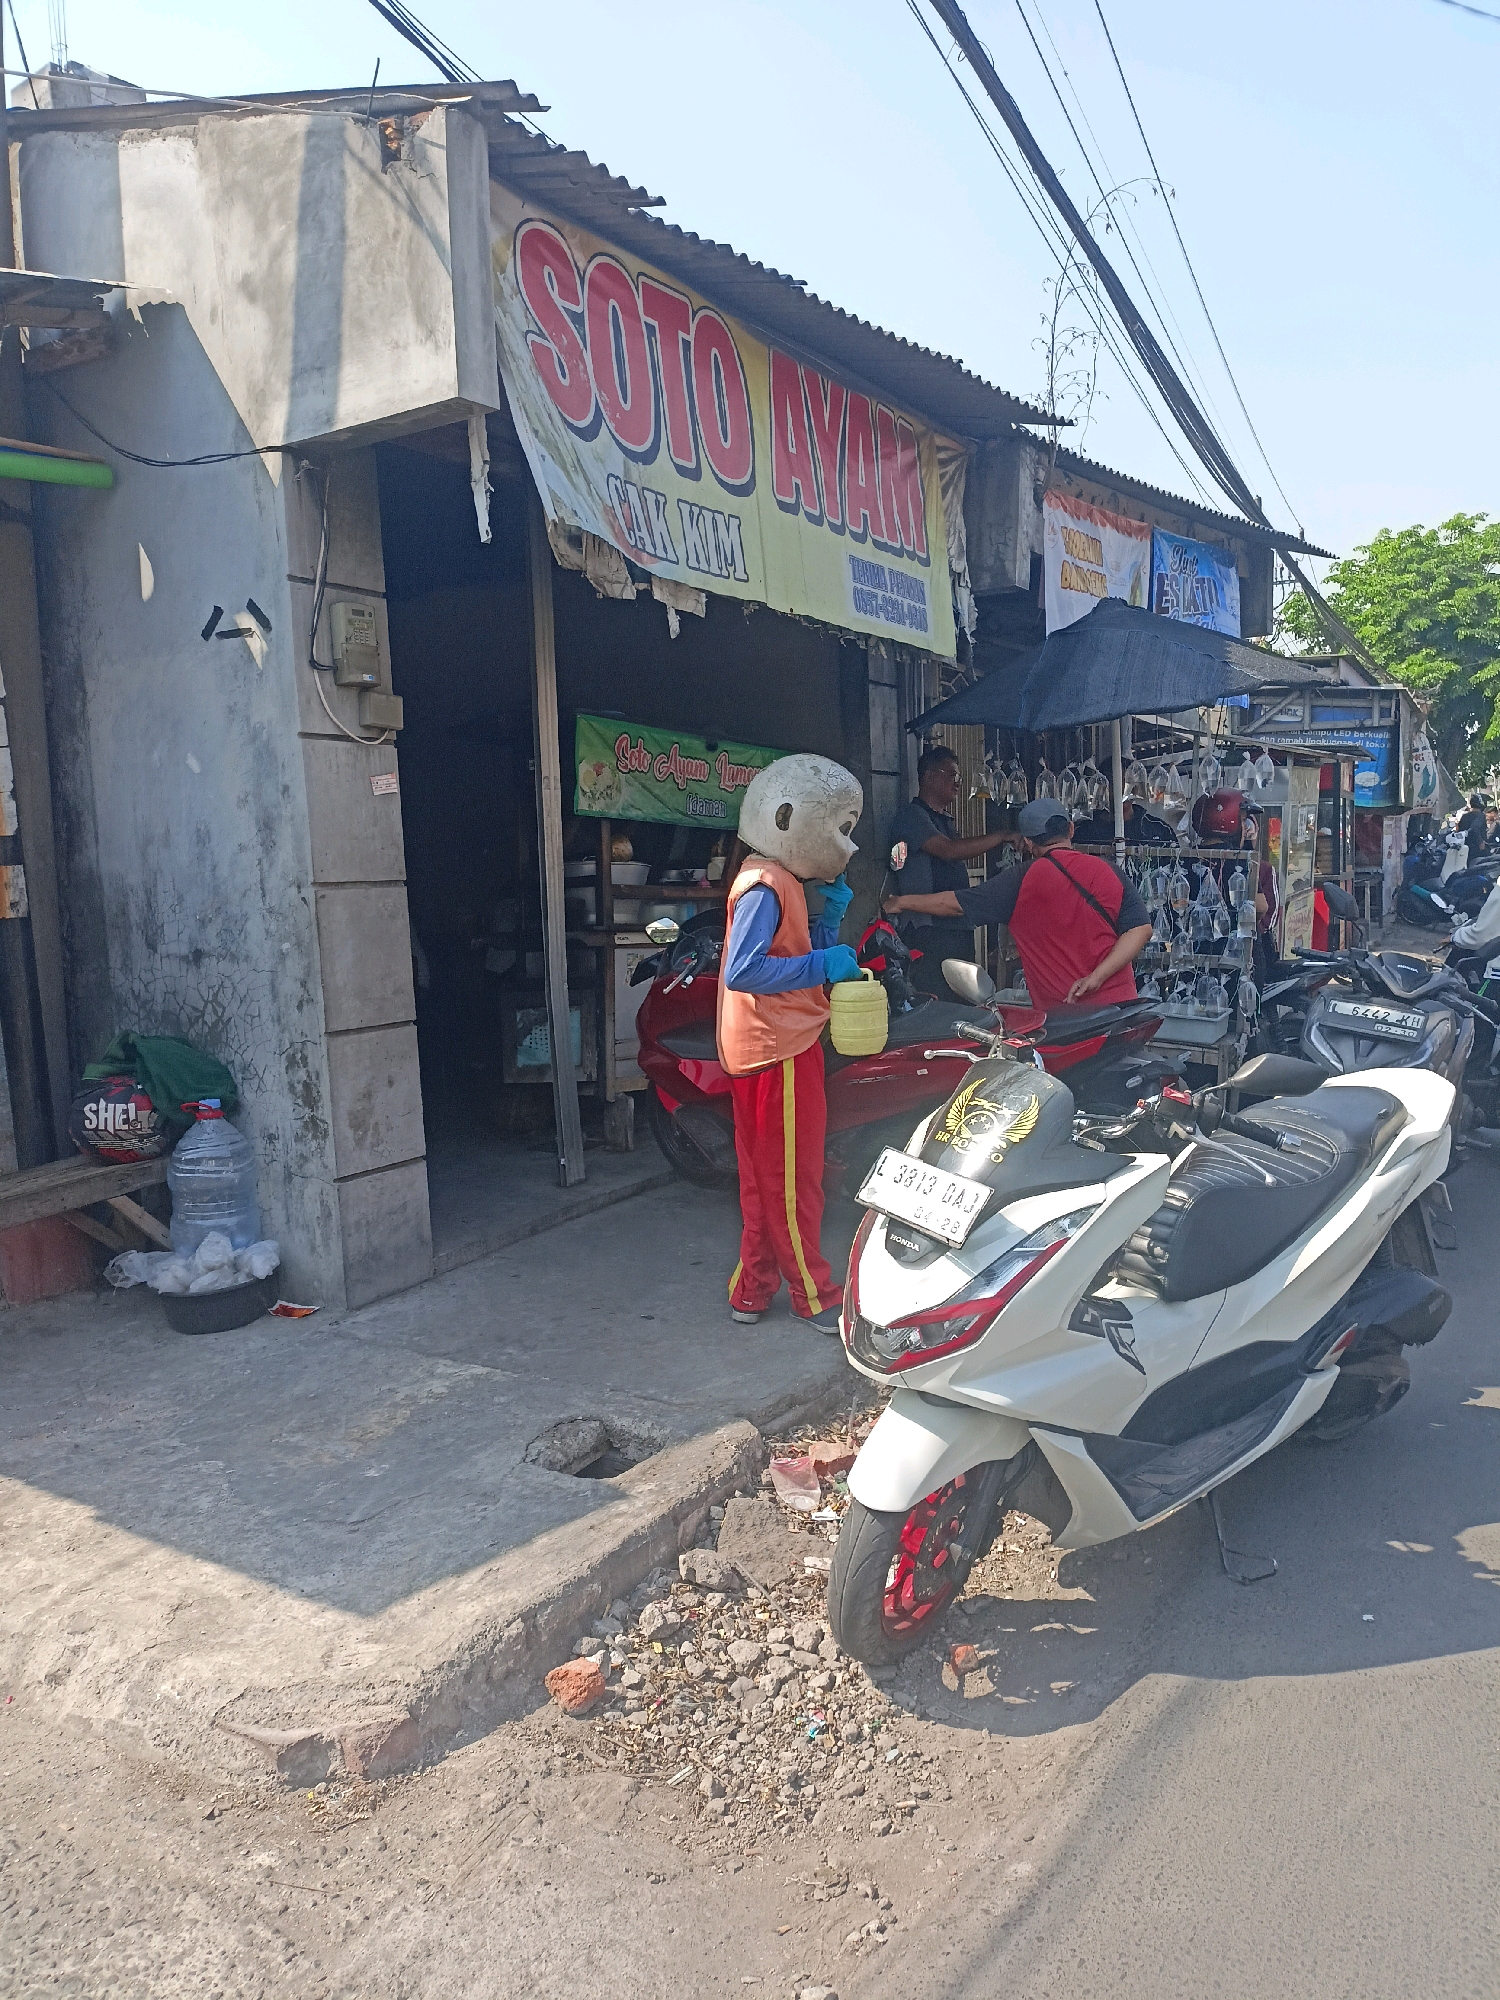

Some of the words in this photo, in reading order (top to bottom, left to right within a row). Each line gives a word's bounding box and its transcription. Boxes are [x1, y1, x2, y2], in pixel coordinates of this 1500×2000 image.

[514, 218, 756, 497] SOTO
[768, 344, 931, 567] AYAM
[607, 473, 679, 565] CAK
[677, 498, 749, 582] KIM
[849, 554, 888, 593] TERIMA
[1154, 571, 1180, 616] ES
[1333, 729, 1351, 737] LED
[614, 732, 653, 774] Soto
[653, 742, 710, 790] Ayam
[686, 793, 727, 818] Idaman
[1351, 1006, 1391, 1021] 6442
[876, 1155, 888, 1177] L
[893, 1164, 938, 1196] 3813
[889, 1233, 920, 1252] HONDA
